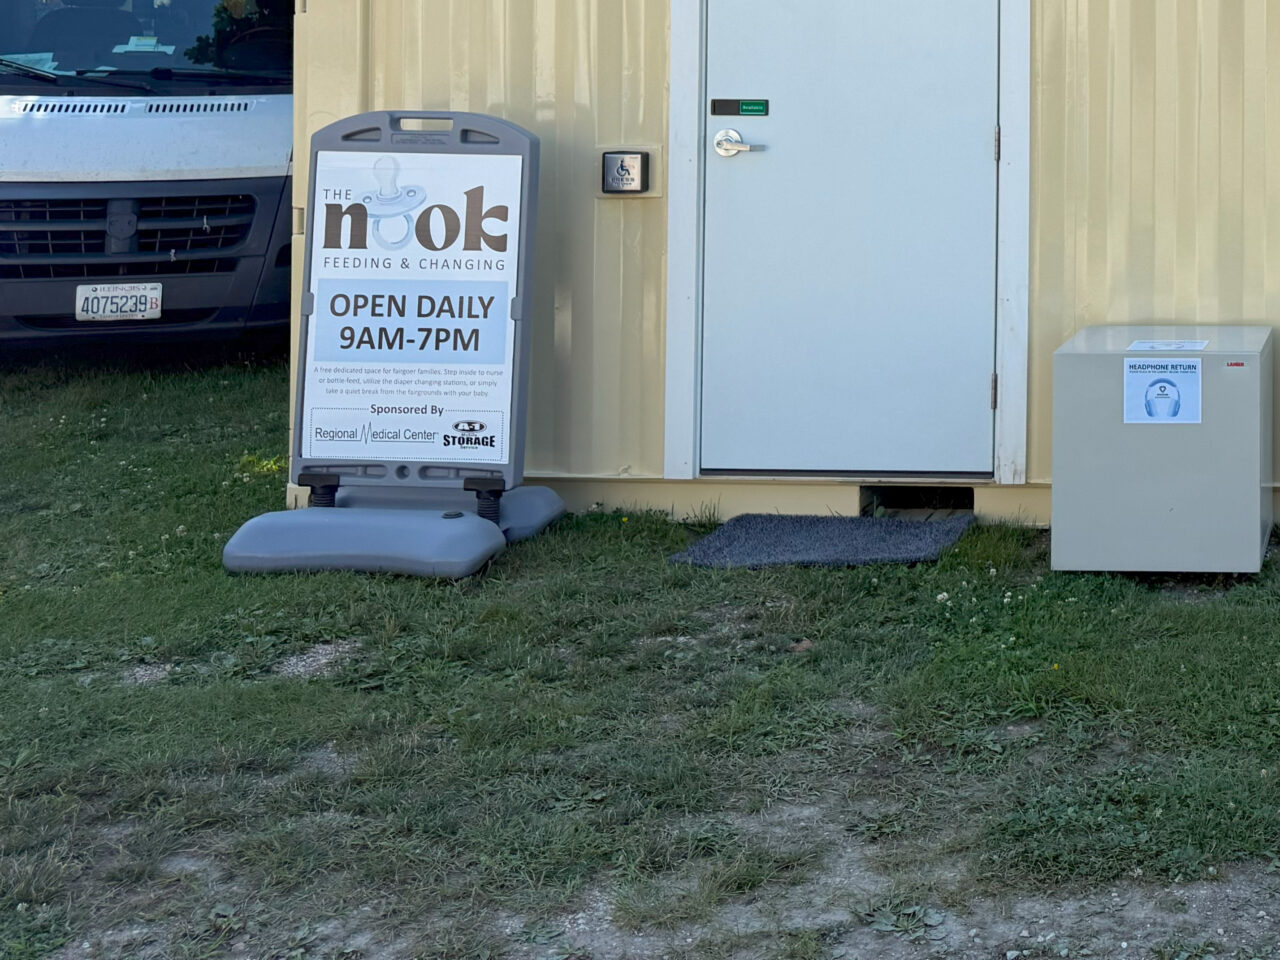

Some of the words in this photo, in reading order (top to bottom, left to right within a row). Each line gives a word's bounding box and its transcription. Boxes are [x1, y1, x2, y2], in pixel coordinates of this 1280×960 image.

[323, 189, 352, 200] THE
[324, 257, 392, 268] FEEDING
[400, 258, 410, 269] &
[419, 258, 506, 270] CHANGING
[81, 295, 147, 314] 4075239
[149, 297, 159, 310] B
[329, 293, 407, 317] OPEN
[417, 295, 495, 319] DAILY
[339, 326, 480, 351] 9AM-7PM
[370, 404, 427, 415] Sponsored
[431, 405, 444, 416] By
[315, 427, 358, 440] Regional
[360, 421, 400, 444] Medical
[403, 429, 436, 440] Center
[458, 422, 480, 430] A-1
[443, 434, 495, 447] STORAGE
